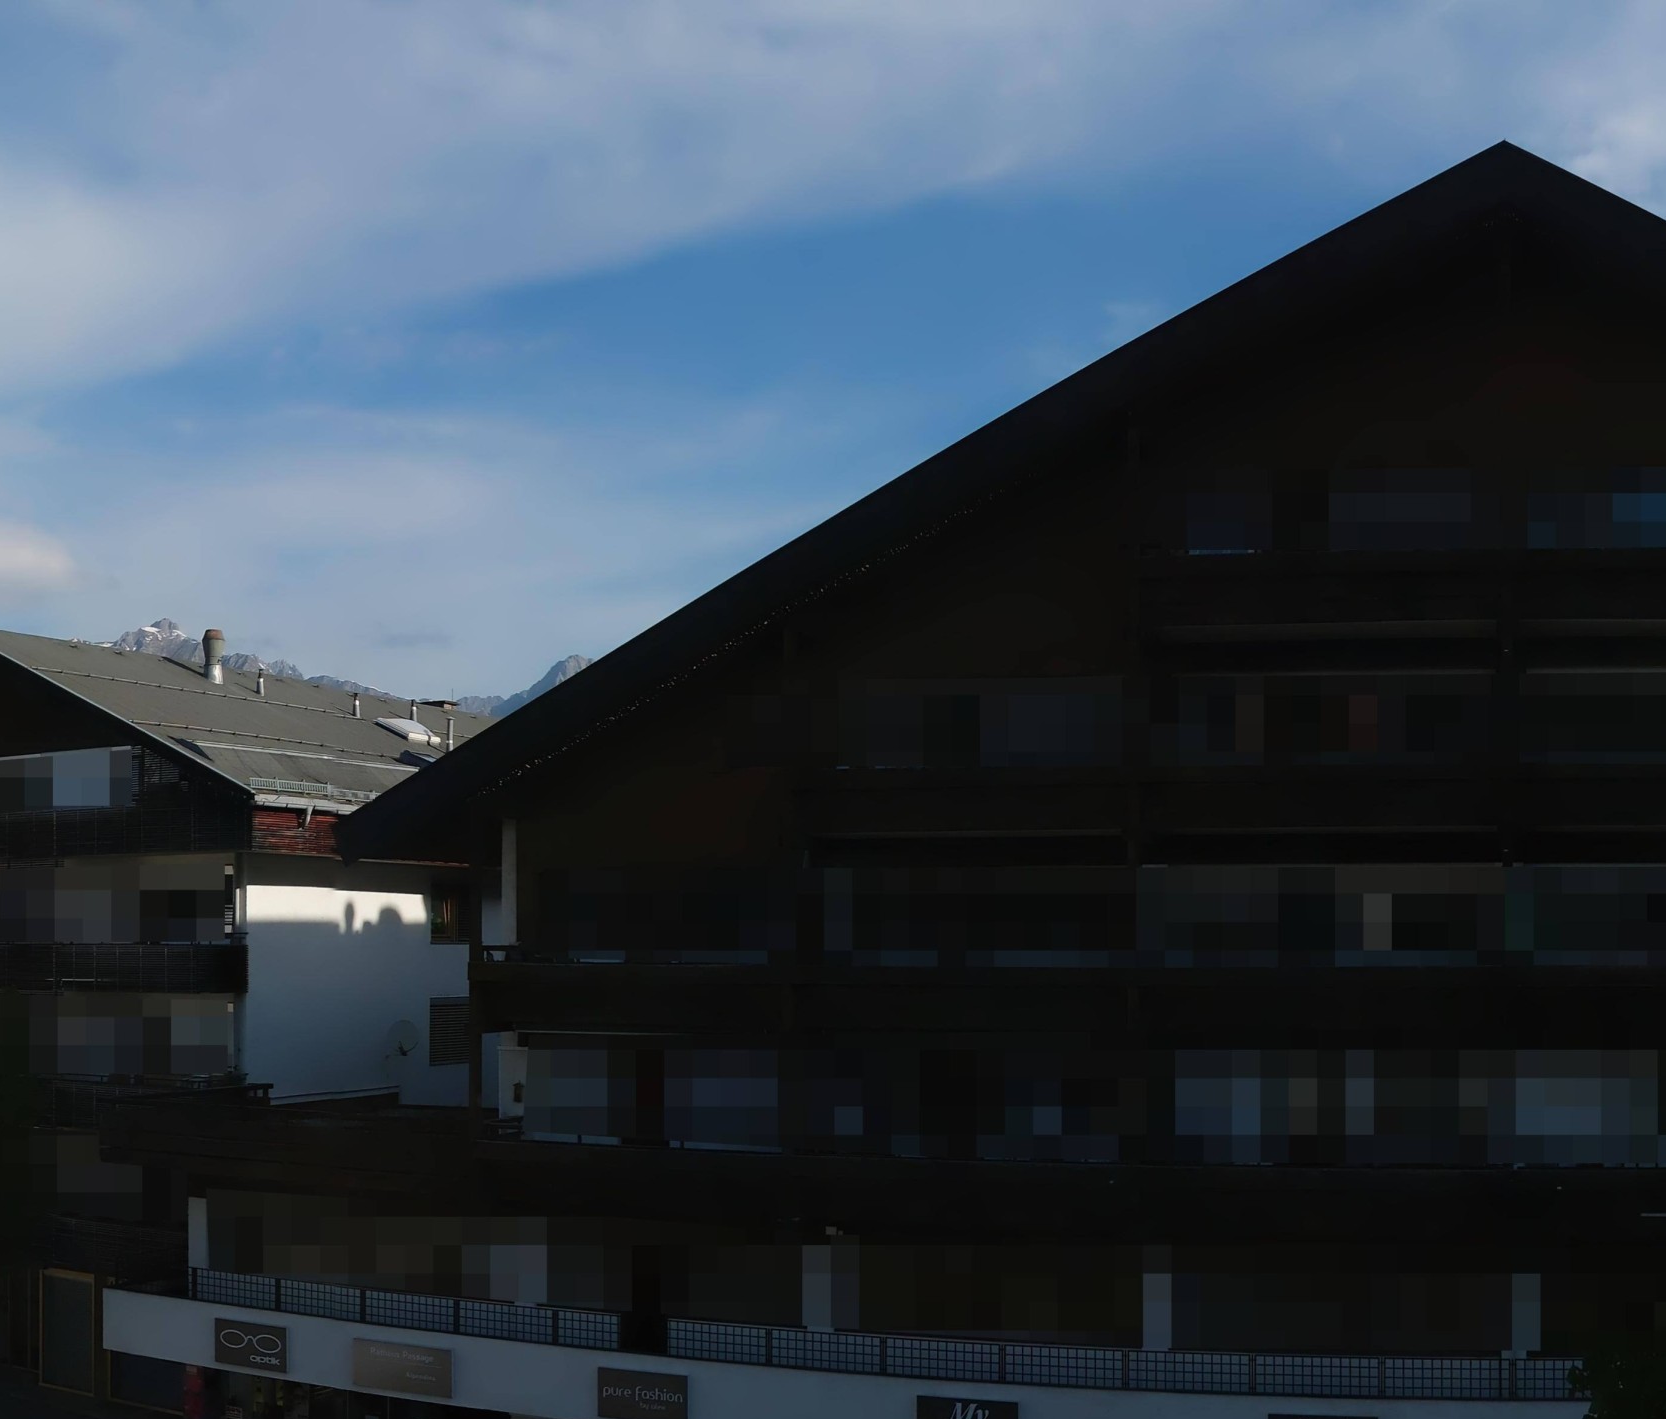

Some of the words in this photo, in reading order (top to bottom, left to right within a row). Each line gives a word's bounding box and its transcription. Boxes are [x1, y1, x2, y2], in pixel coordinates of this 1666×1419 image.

[249, 1354, 281, 1366] optik
[403, 1350, 434, 1363] Passage
[602, 1386, 632, 1398] pure
[635, 1385, 683, 1403] fashion
